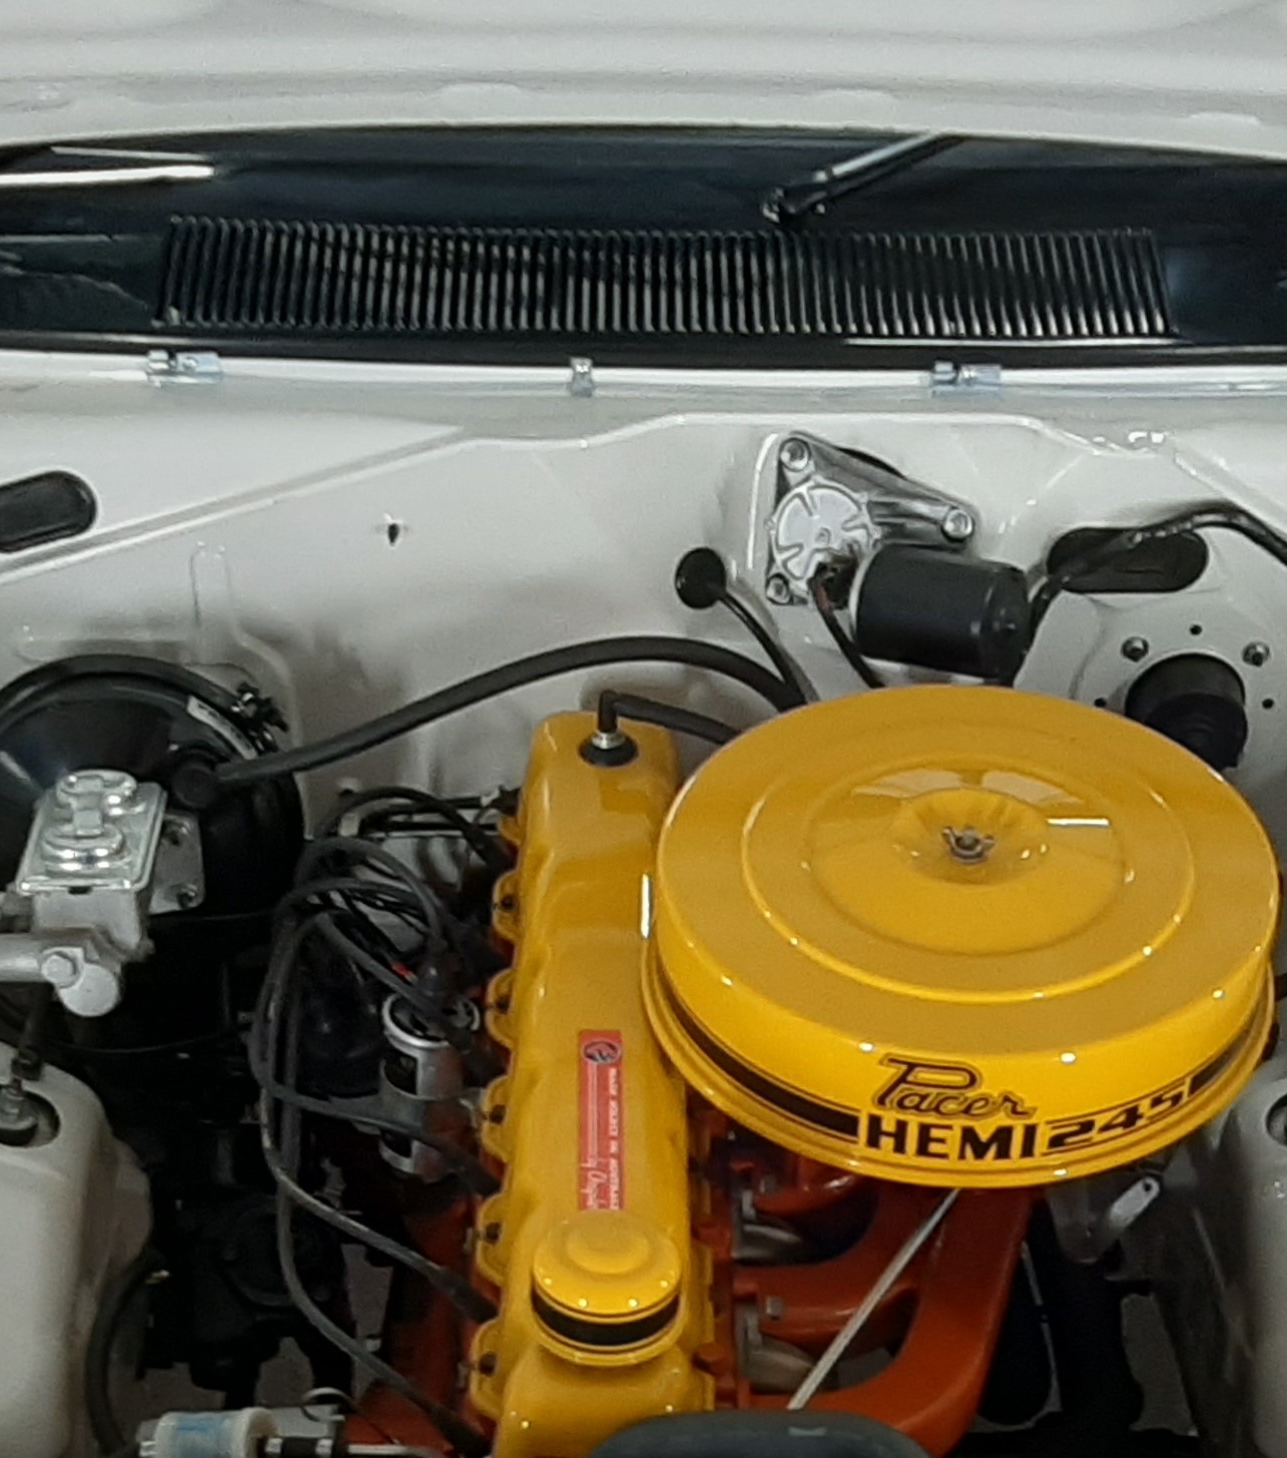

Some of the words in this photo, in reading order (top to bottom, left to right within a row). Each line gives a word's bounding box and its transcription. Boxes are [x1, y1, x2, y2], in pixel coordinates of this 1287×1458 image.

[866, 1113, 1039, 1161] HEMI
[1047, 1079, 1187, 1151] 245
[874, 1054, 1036, 1119] Pacer
